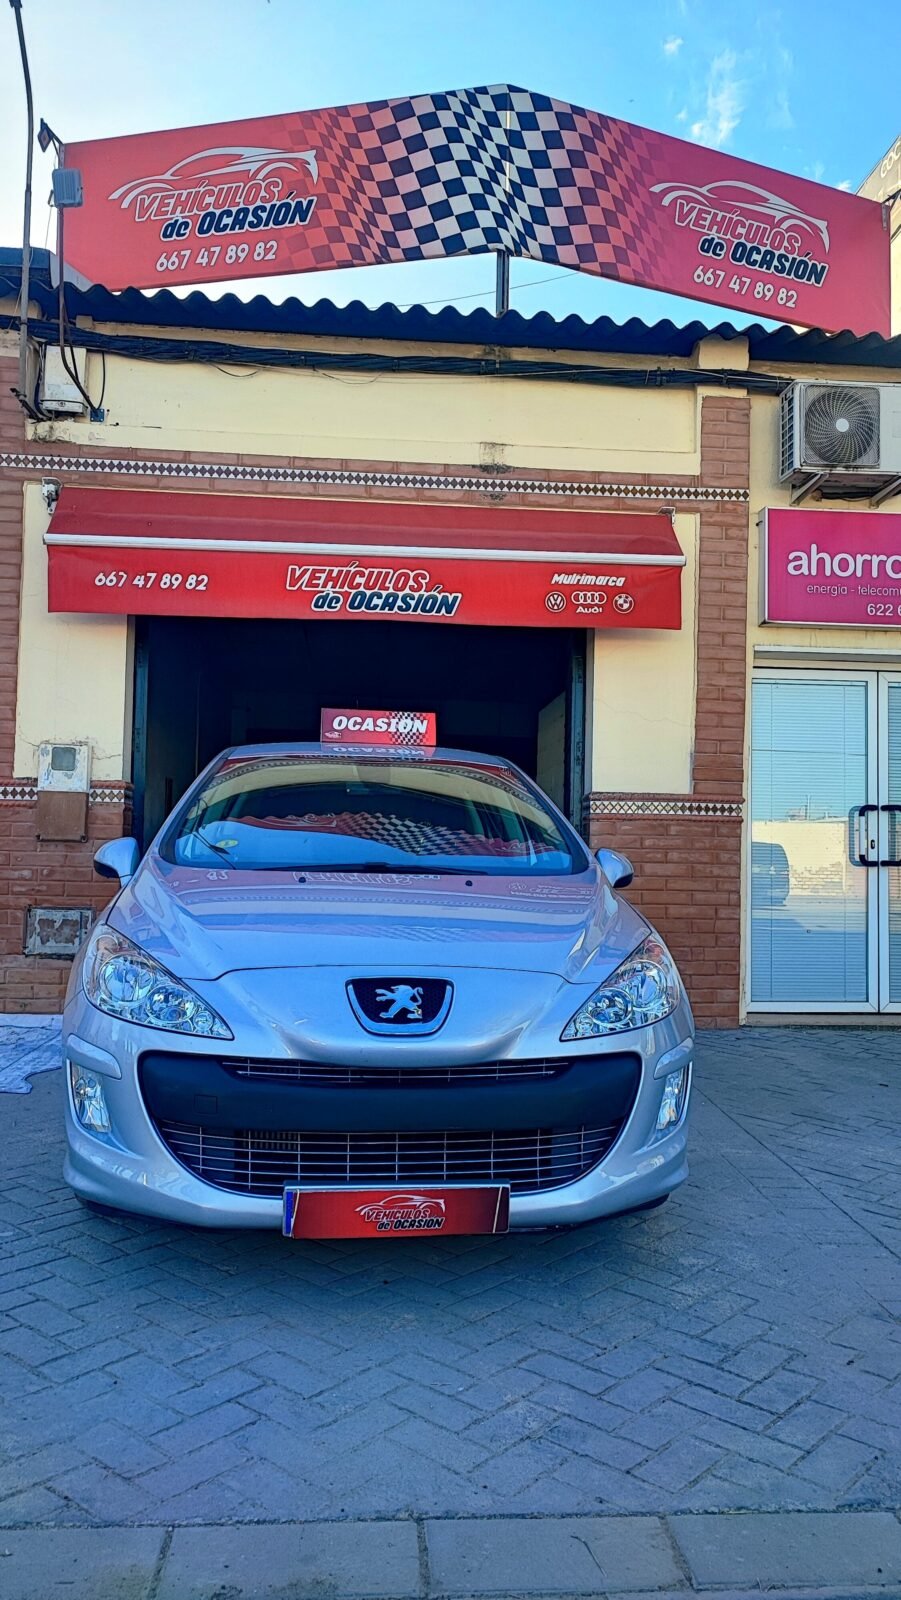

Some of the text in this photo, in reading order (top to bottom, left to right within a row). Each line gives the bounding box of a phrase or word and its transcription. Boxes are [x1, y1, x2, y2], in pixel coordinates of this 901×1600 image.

[136, 180, 281, 221] VEHÍCULOS
[160, 191, 316, 242] de OCASIÓN
[676, 199, 801, 254] VEHÍCULOS
[156, 238, 278, 272] 667 47 89 82
[699, 235, 828, 287] de OCASIÓN
[693, 264, 798, 309] 667 47 89 82
[94, 571, 209, 591] 667 47 89 82
[286, 561, 430, 592] VEHÍCULOS
[858, 584, 901, 596] telecom
[311, 585, 463, 617] de OCASIÓN
[867, 604, 894, 616] 622
[377, 1221, 391, 1231] de
